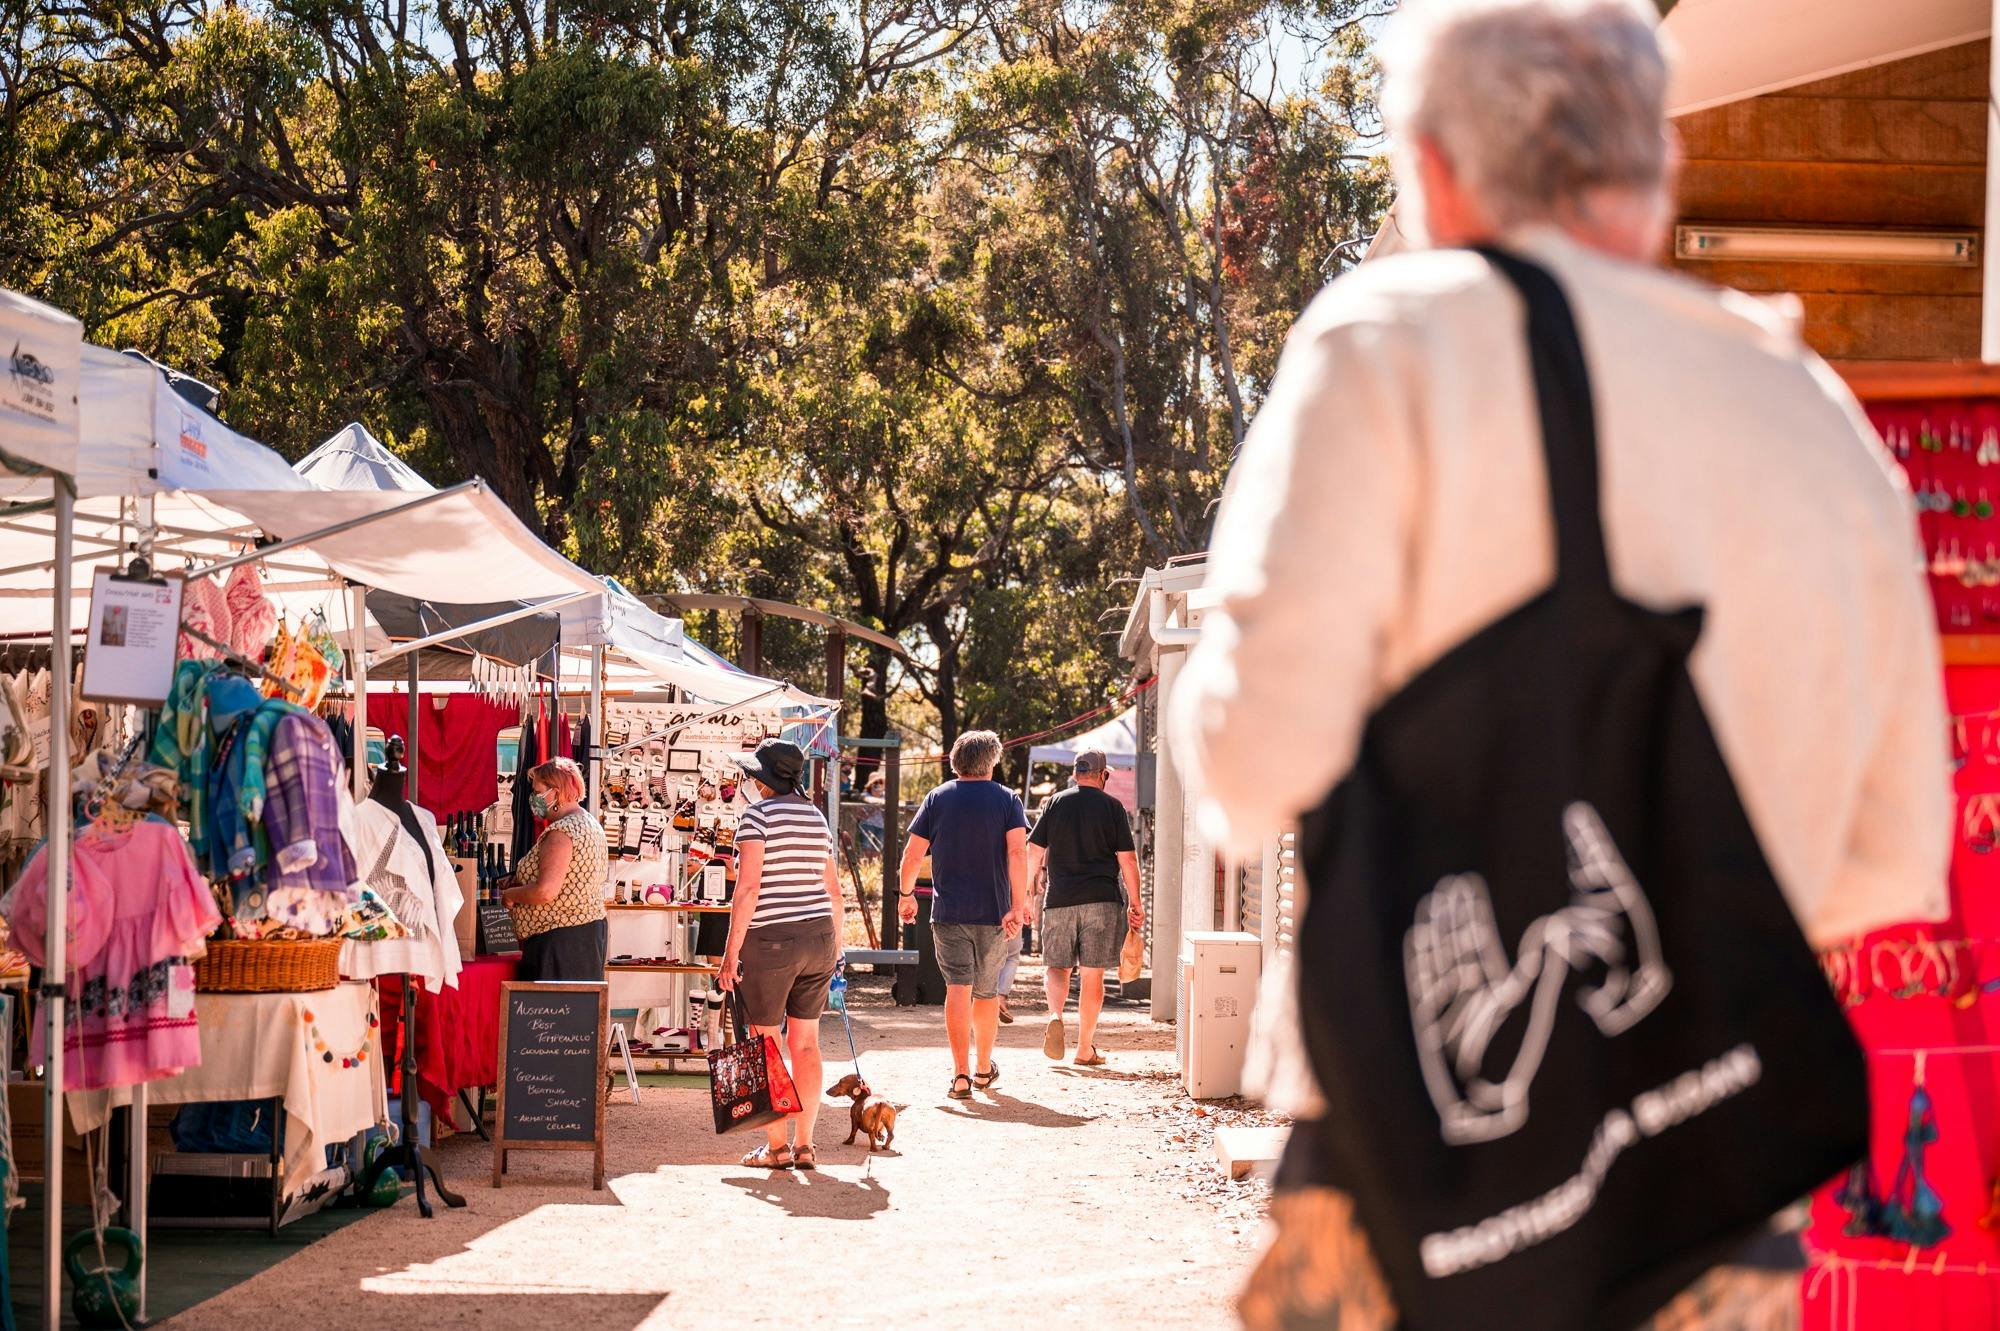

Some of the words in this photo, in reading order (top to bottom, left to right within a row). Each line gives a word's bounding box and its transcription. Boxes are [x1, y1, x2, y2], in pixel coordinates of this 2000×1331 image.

[529, 1018, 556, 1031] BEST
[563, 1048, 591, 1056] CELLARS
[546, 1122, 581, 1131] CELLARS
